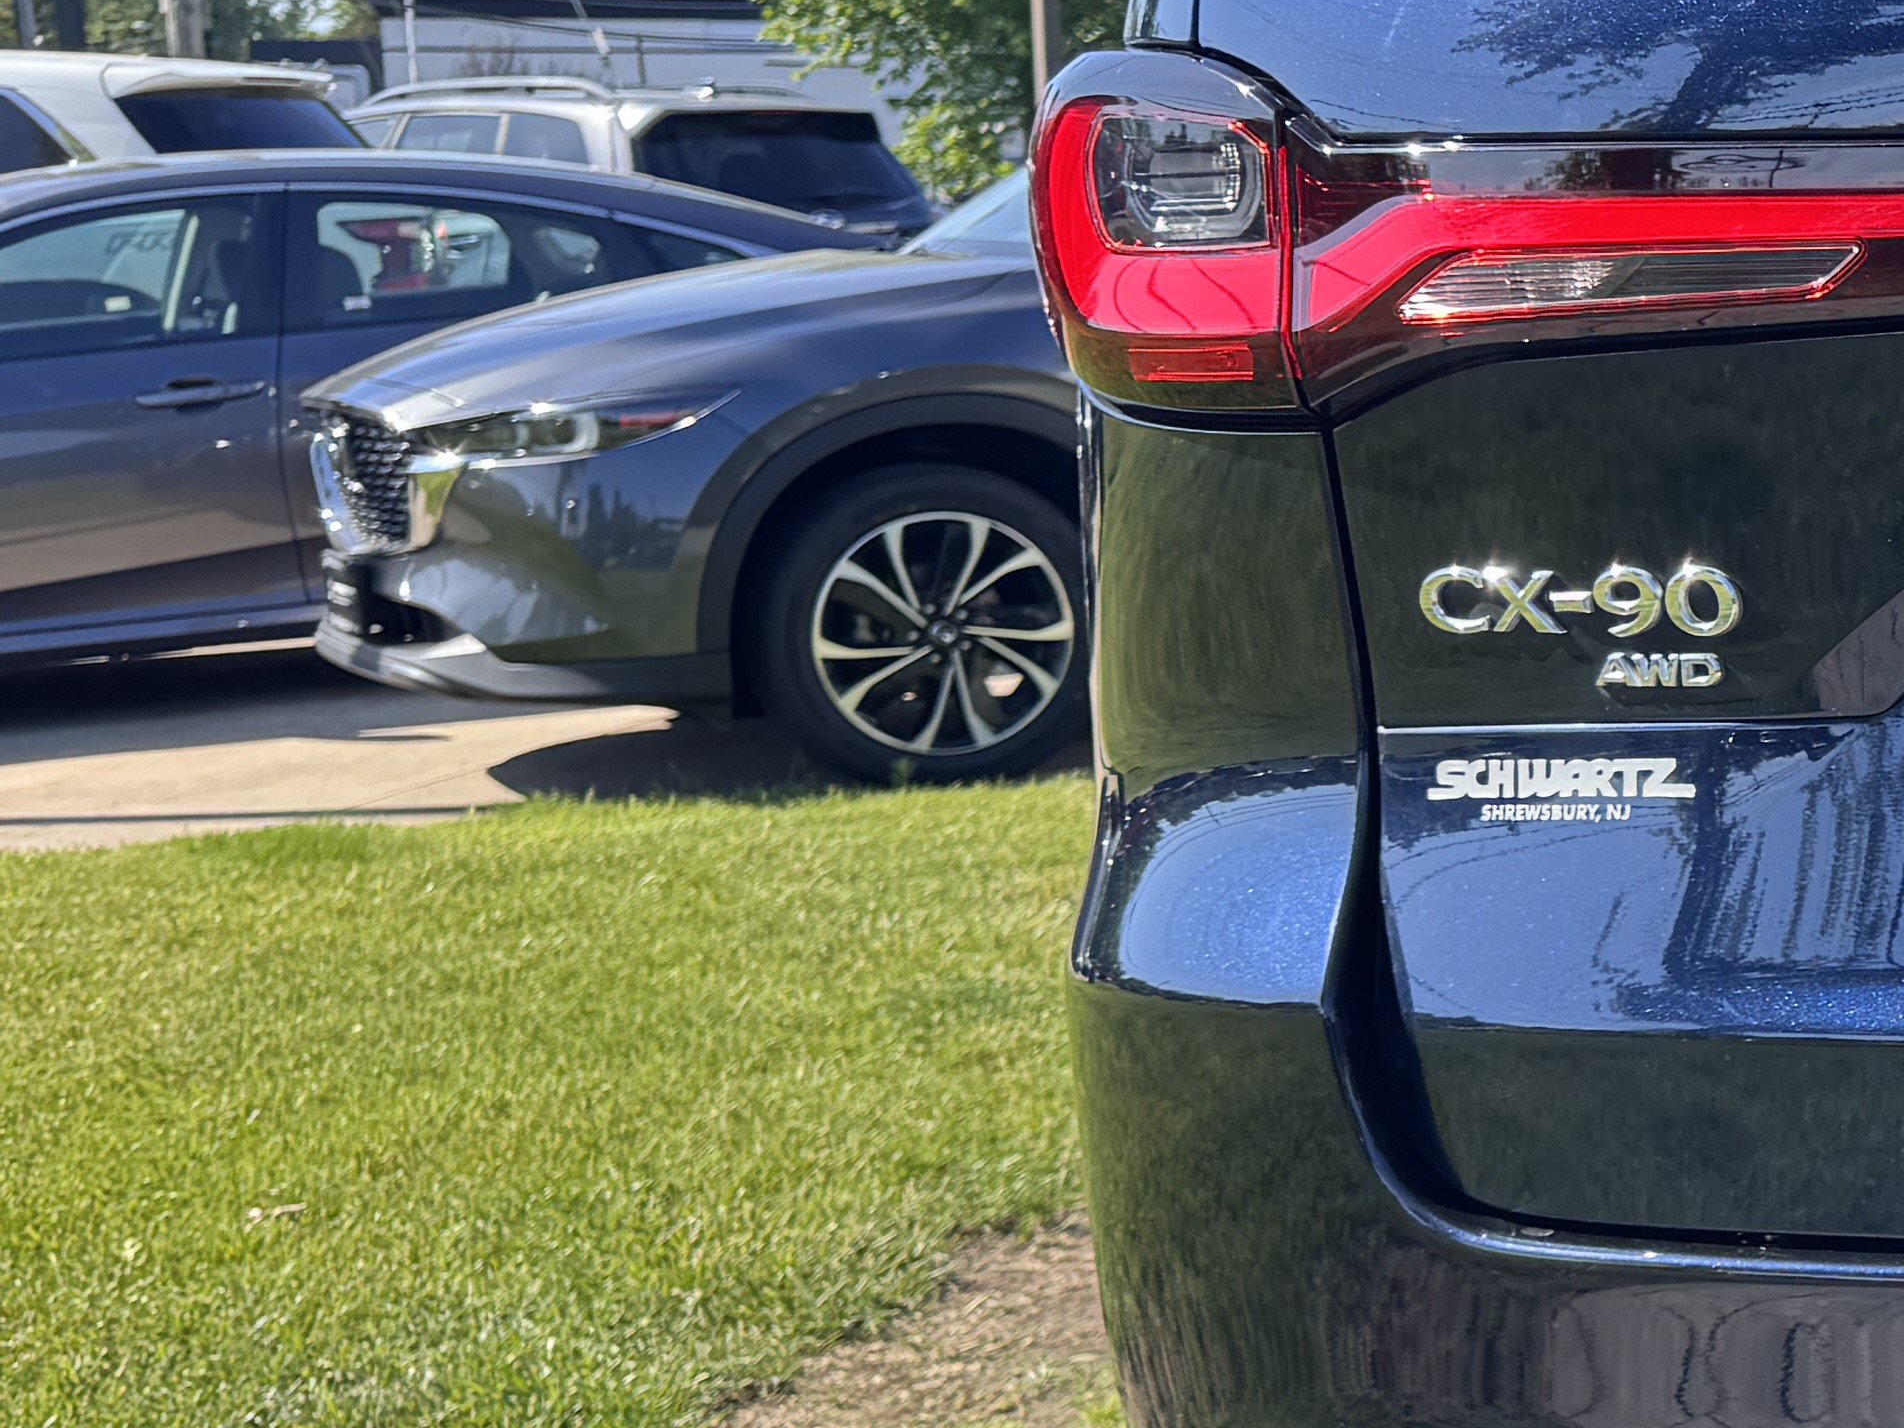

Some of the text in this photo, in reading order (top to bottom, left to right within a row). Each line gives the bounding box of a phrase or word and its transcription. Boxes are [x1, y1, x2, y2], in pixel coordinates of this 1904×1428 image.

[1419, 565, 1743, 637] CX-90
[1596, 652, 1724, 687] AWD
[1428, 758, 1696, 800] SCHWARTZ
[1481, 804, 1631, 822] SHREWSBURY, NJ
